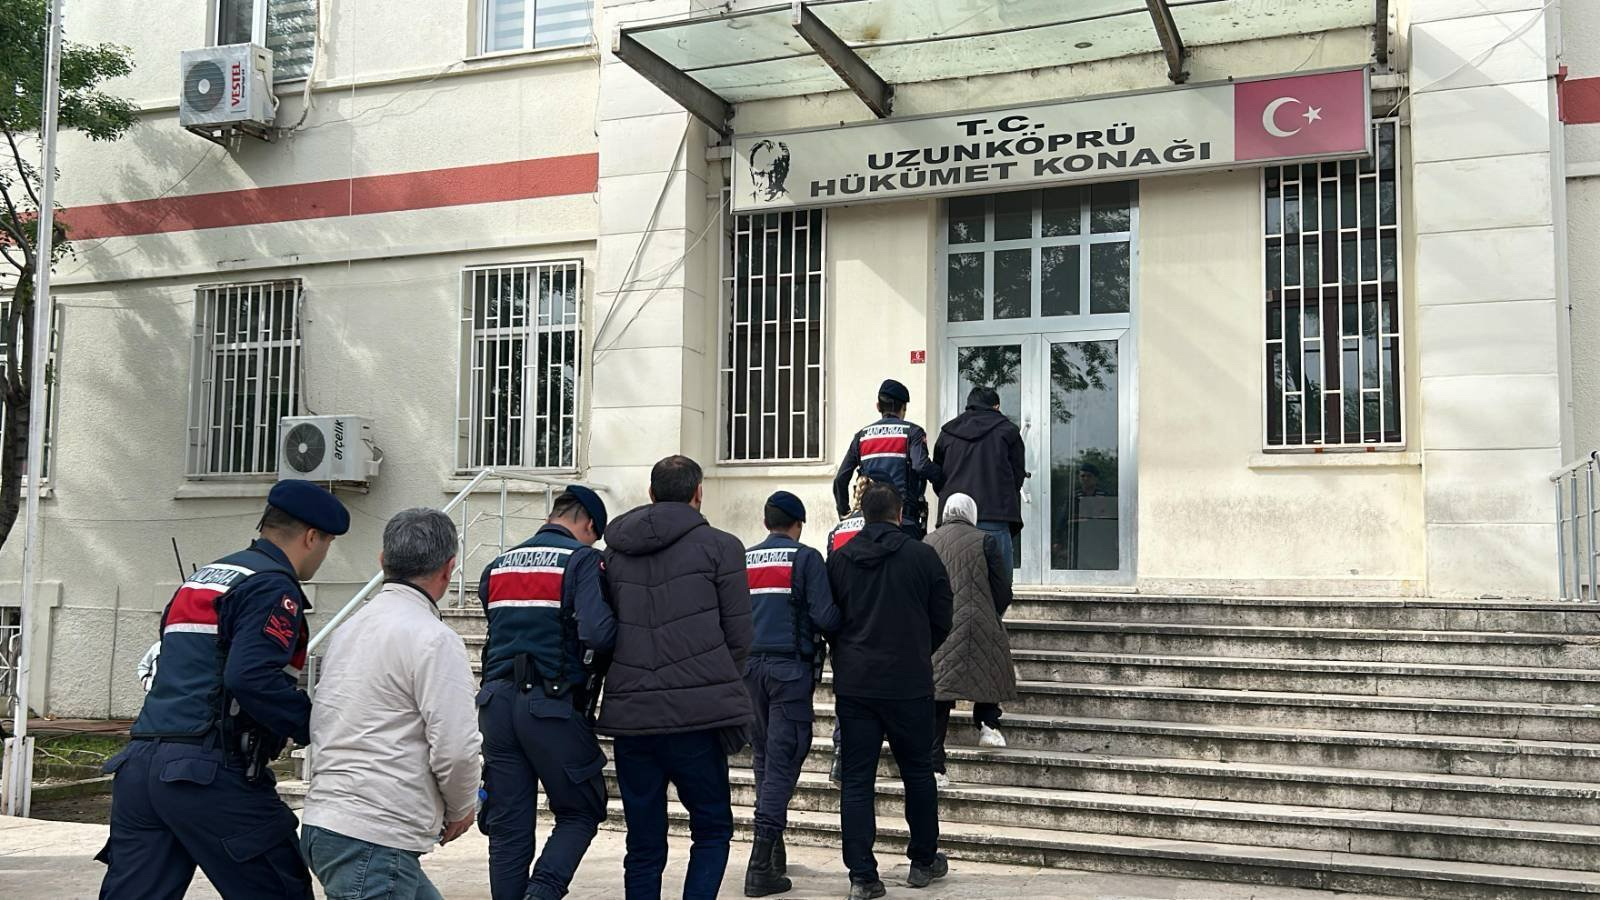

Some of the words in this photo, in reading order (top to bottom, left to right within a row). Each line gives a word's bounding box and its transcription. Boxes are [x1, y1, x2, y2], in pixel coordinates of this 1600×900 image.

[231, 61, 241, 107] VESTEL
[868, 122, 1135, 170] UZUNKÖPRÜ
[957, 115, 1045, 136] T.C.
[810, 163, 1018, 197] HÜKÜMET
[1034, 138, 1211, 176] KONAĞI
[334, 419, 344, 460] arçelik
[499, 552, 559, 567] JANDARMA
[746, 551, 788, 564] ANDARMA
